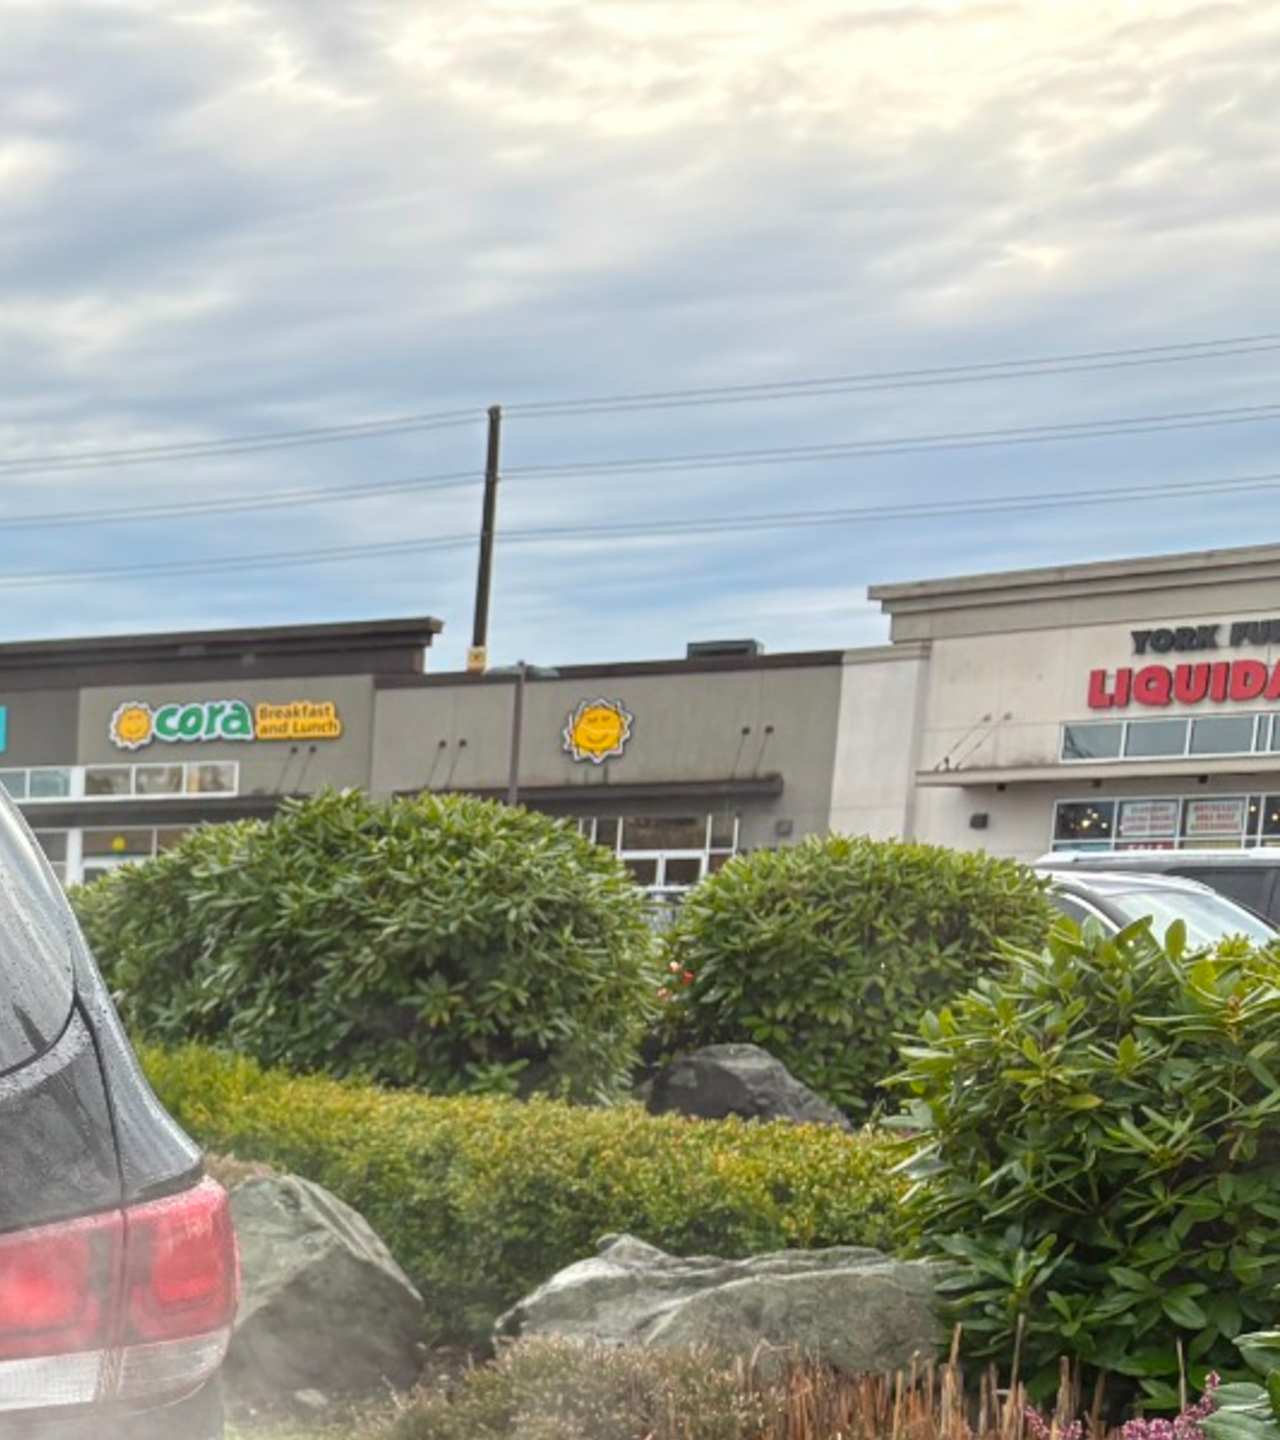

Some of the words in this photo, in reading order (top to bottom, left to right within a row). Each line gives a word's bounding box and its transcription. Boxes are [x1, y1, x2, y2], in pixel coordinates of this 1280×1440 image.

[1131, 624, 1219, 655] YORK
[155, 702, 251, 736] cora
[259, 703, 332, 720] Breakfast
[259, 720, 288, 734] and
[292, 718, 338, 734] Lunch
